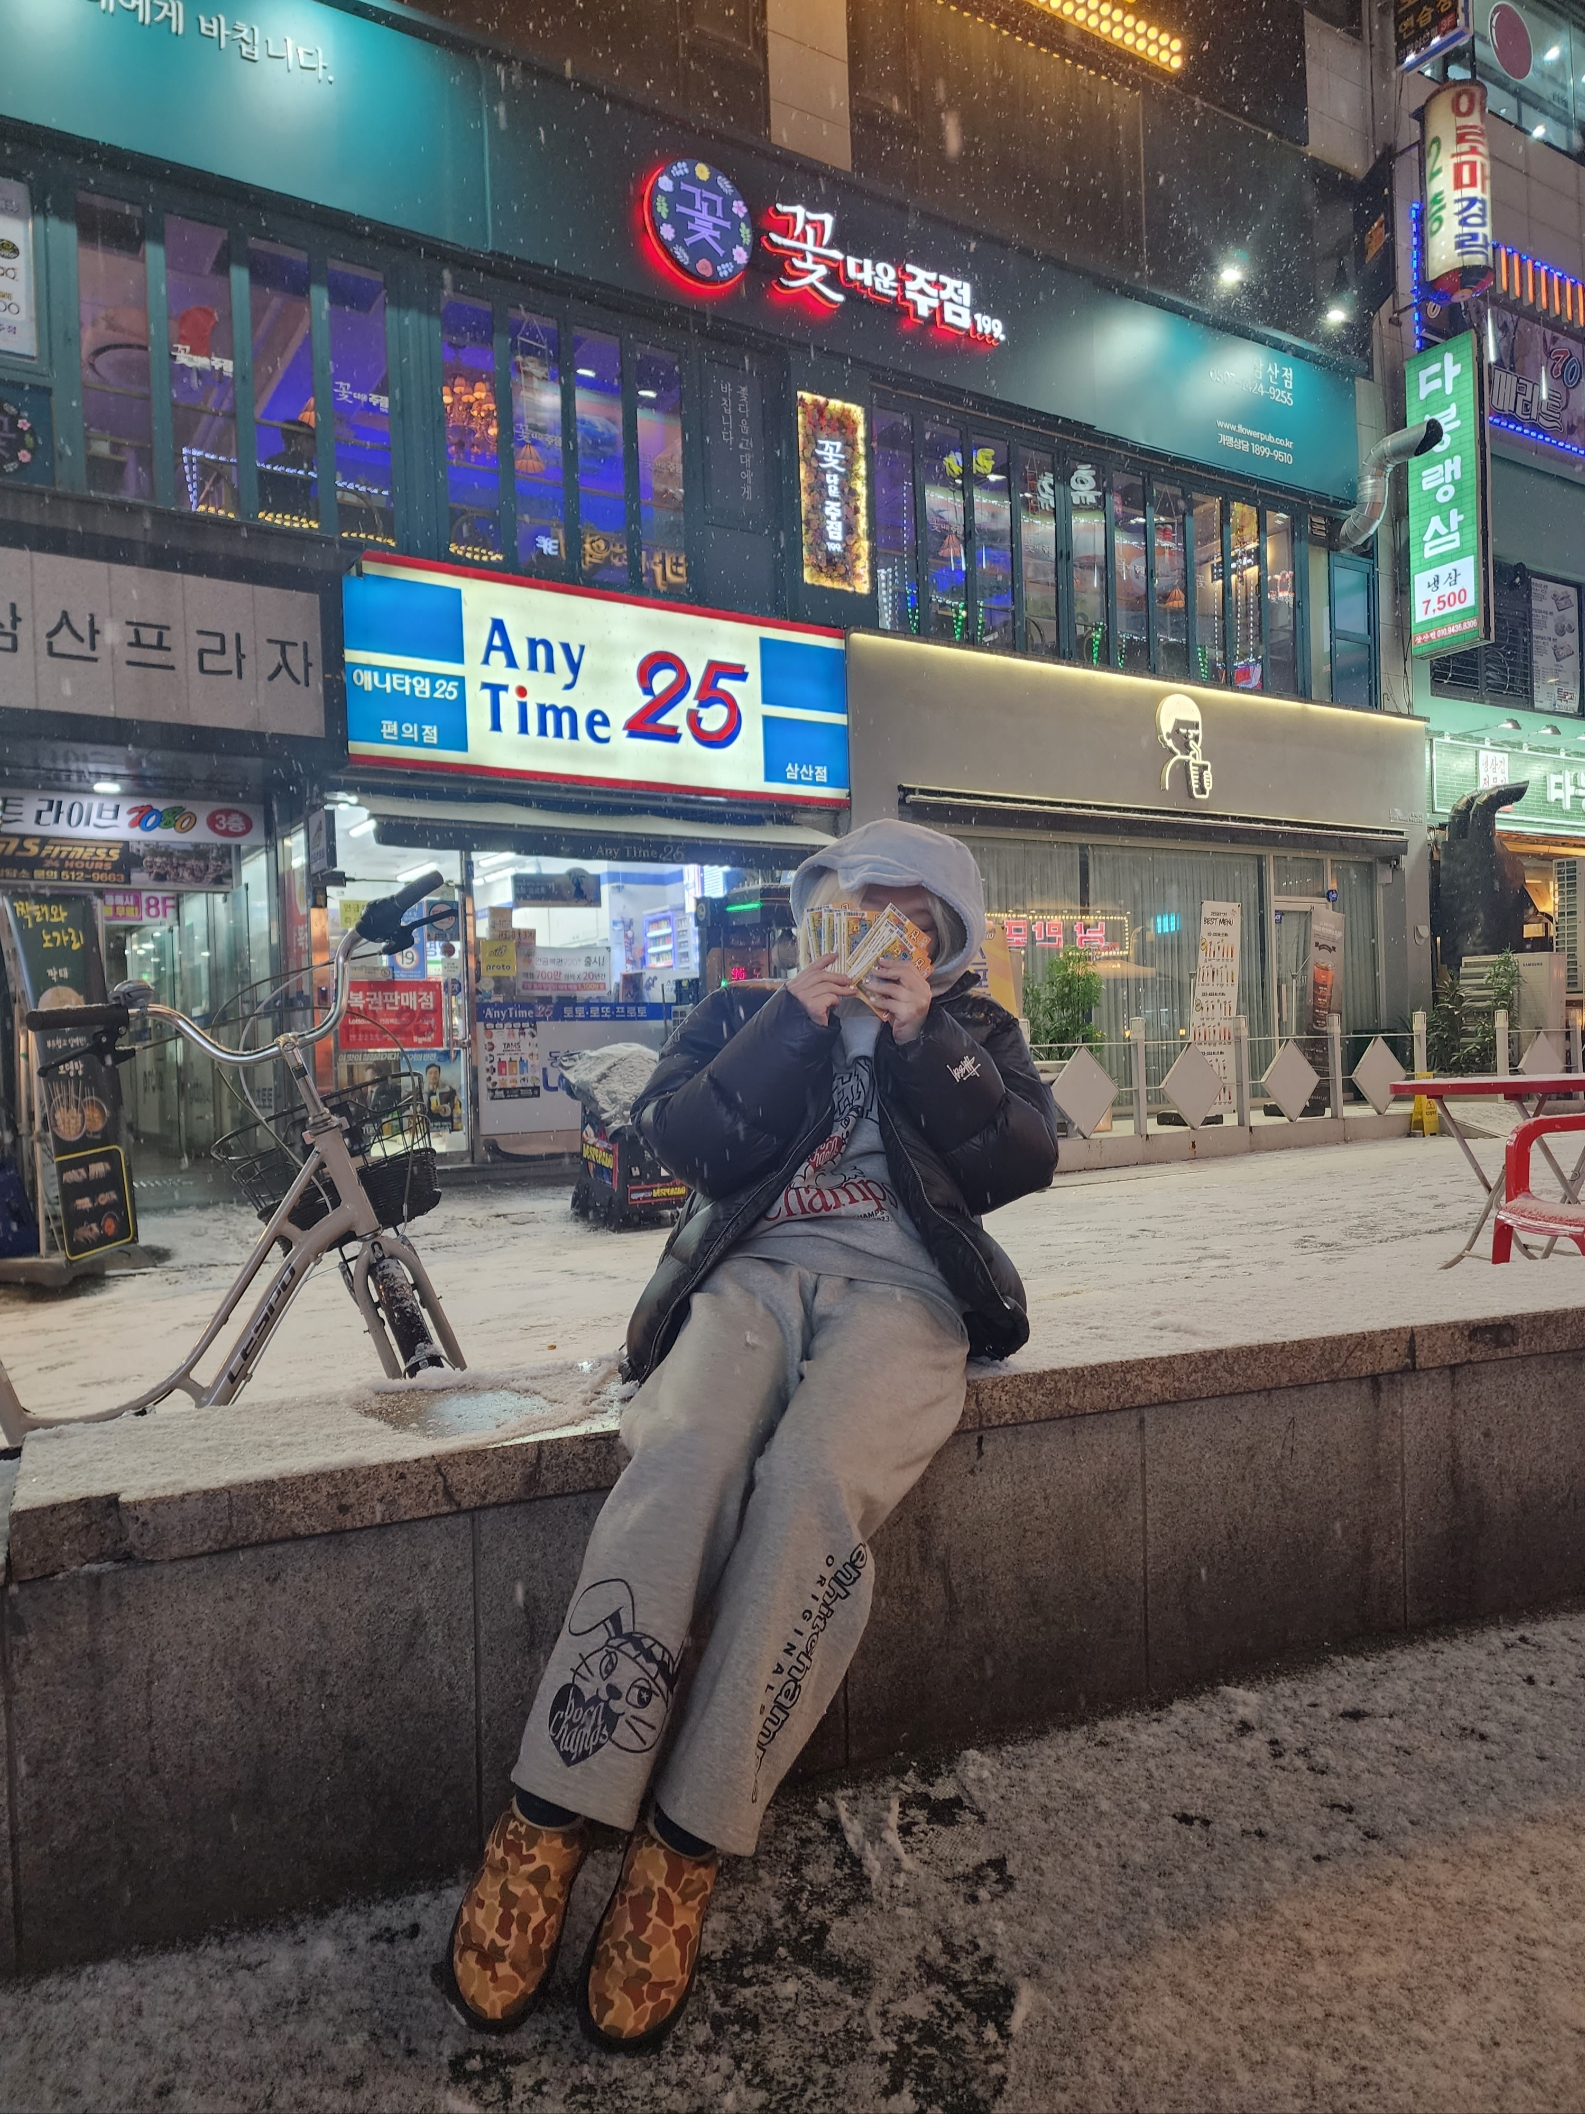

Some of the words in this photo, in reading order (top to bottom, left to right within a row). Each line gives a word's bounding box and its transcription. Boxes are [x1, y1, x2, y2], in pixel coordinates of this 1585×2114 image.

[198, 13, 335, 84] 바칩니다.
[1251, 442, 1294, 466] 1899-9510
[1421, 588, 1468, 616] 7,500
[480, 617, 586, 691] Any
[352, 668, 430, 699] 애니타임
[432, 680, 459, 701] 25
[479, 680, 612, 745] Time
[623, 650, 749, 750] 25
[379, 718, 438, 746] 편의점
[785, 761, 829, 783] 삼산점
[1546, 769, 1585, 813] 다
[34, 797, 121, 829] 라이브
[126, 803, 198, 834] 7080
[214, 813, 247, 833] 3층
[64, 860, 113, 871] HOURS
[145, 895, 176, 919] 8F
[1203, 916, 1218, 926] BEST
[1218, 918, 1234, 927] MENU
[486, 963, 511, 972] proto
[348, 990, 435, 1011] 복권판매점
